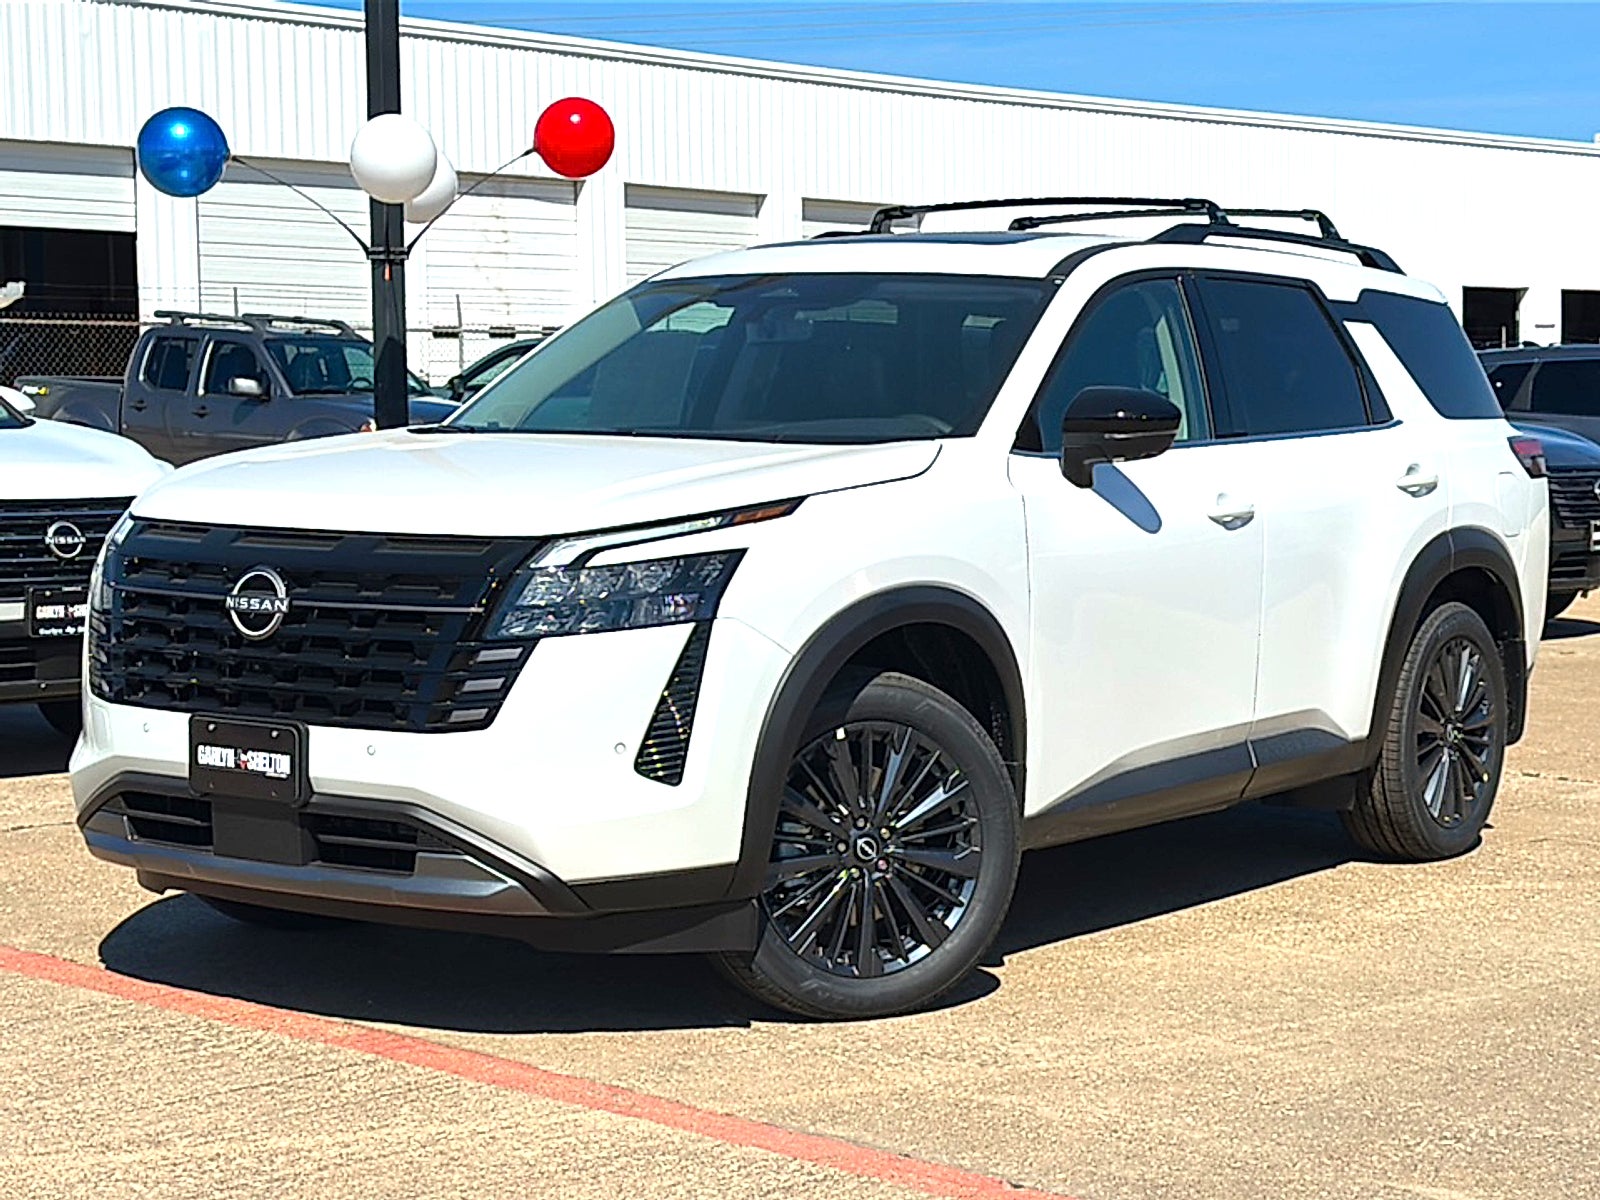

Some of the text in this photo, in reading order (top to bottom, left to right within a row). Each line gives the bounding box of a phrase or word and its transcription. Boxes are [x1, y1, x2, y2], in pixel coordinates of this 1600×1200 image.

[45, 536, 86, 545] NISSAN
[225, 595, 290, 613] NISSAN
[246, 750, 291, 775] SHELTON
